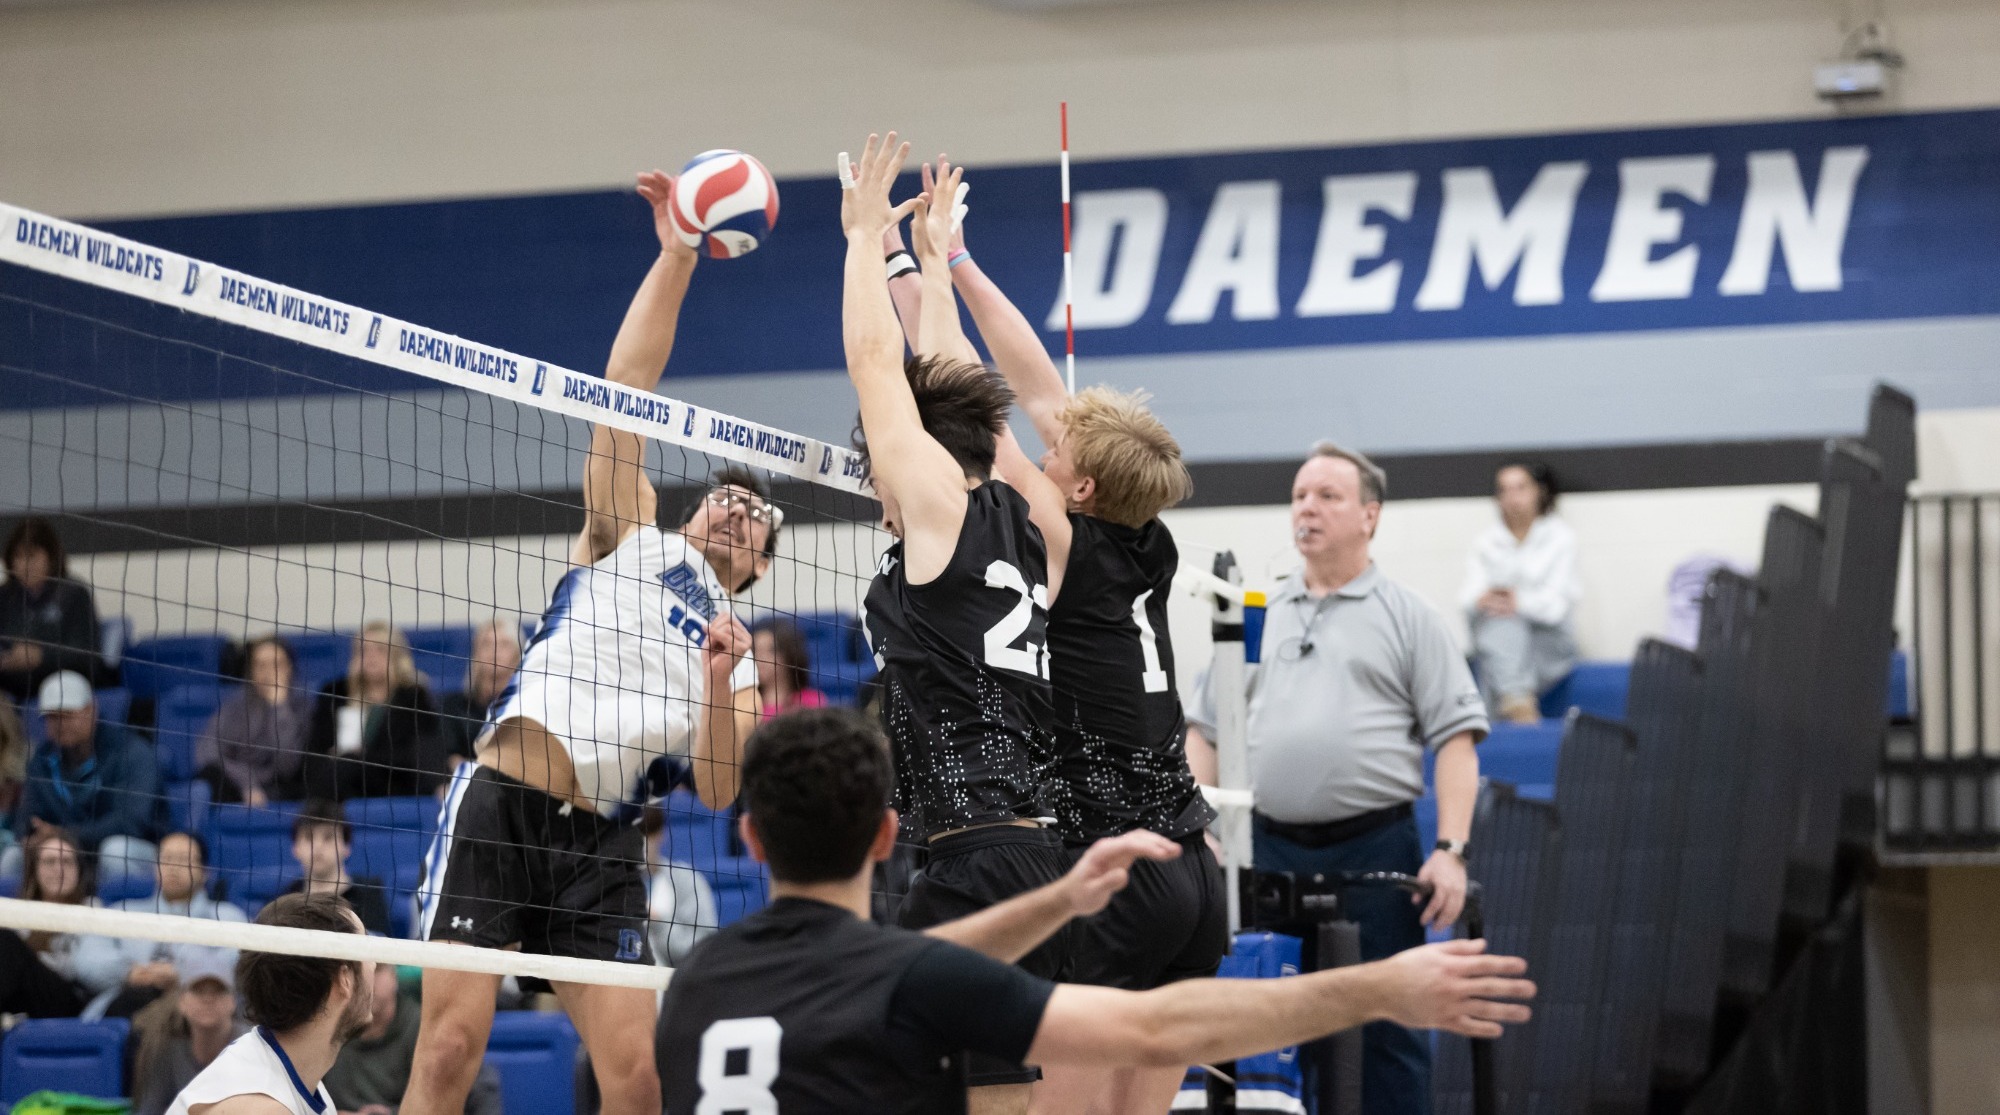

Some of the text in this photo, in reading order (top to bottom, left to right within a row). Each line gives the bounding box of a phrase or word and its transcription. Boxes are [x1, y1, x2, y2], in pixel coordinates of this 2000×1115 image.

[1046, 147, 1870, 331] DAEMEN
[16, 217, 83, 258] DAEMEN
[86, 237, 163, 281] WILDCATS
[220, 275, 278, 315] DAEMEN
[281, 294, 350, 335] WILDCATS
[400, 328, 452, 366] DAEMEN
[455, 344, 518, 384] WILDCATS
[563, 375, 611, 409] DAEMEN
[613, 389, 670, 425] WILDCATS
[709, 417, 754, 451] DAEMEN
[756, 430, 806, 463] WILDCATS
[1132, 588, 1169, 693] 1
[694, 1016, 784, 1115] 8
